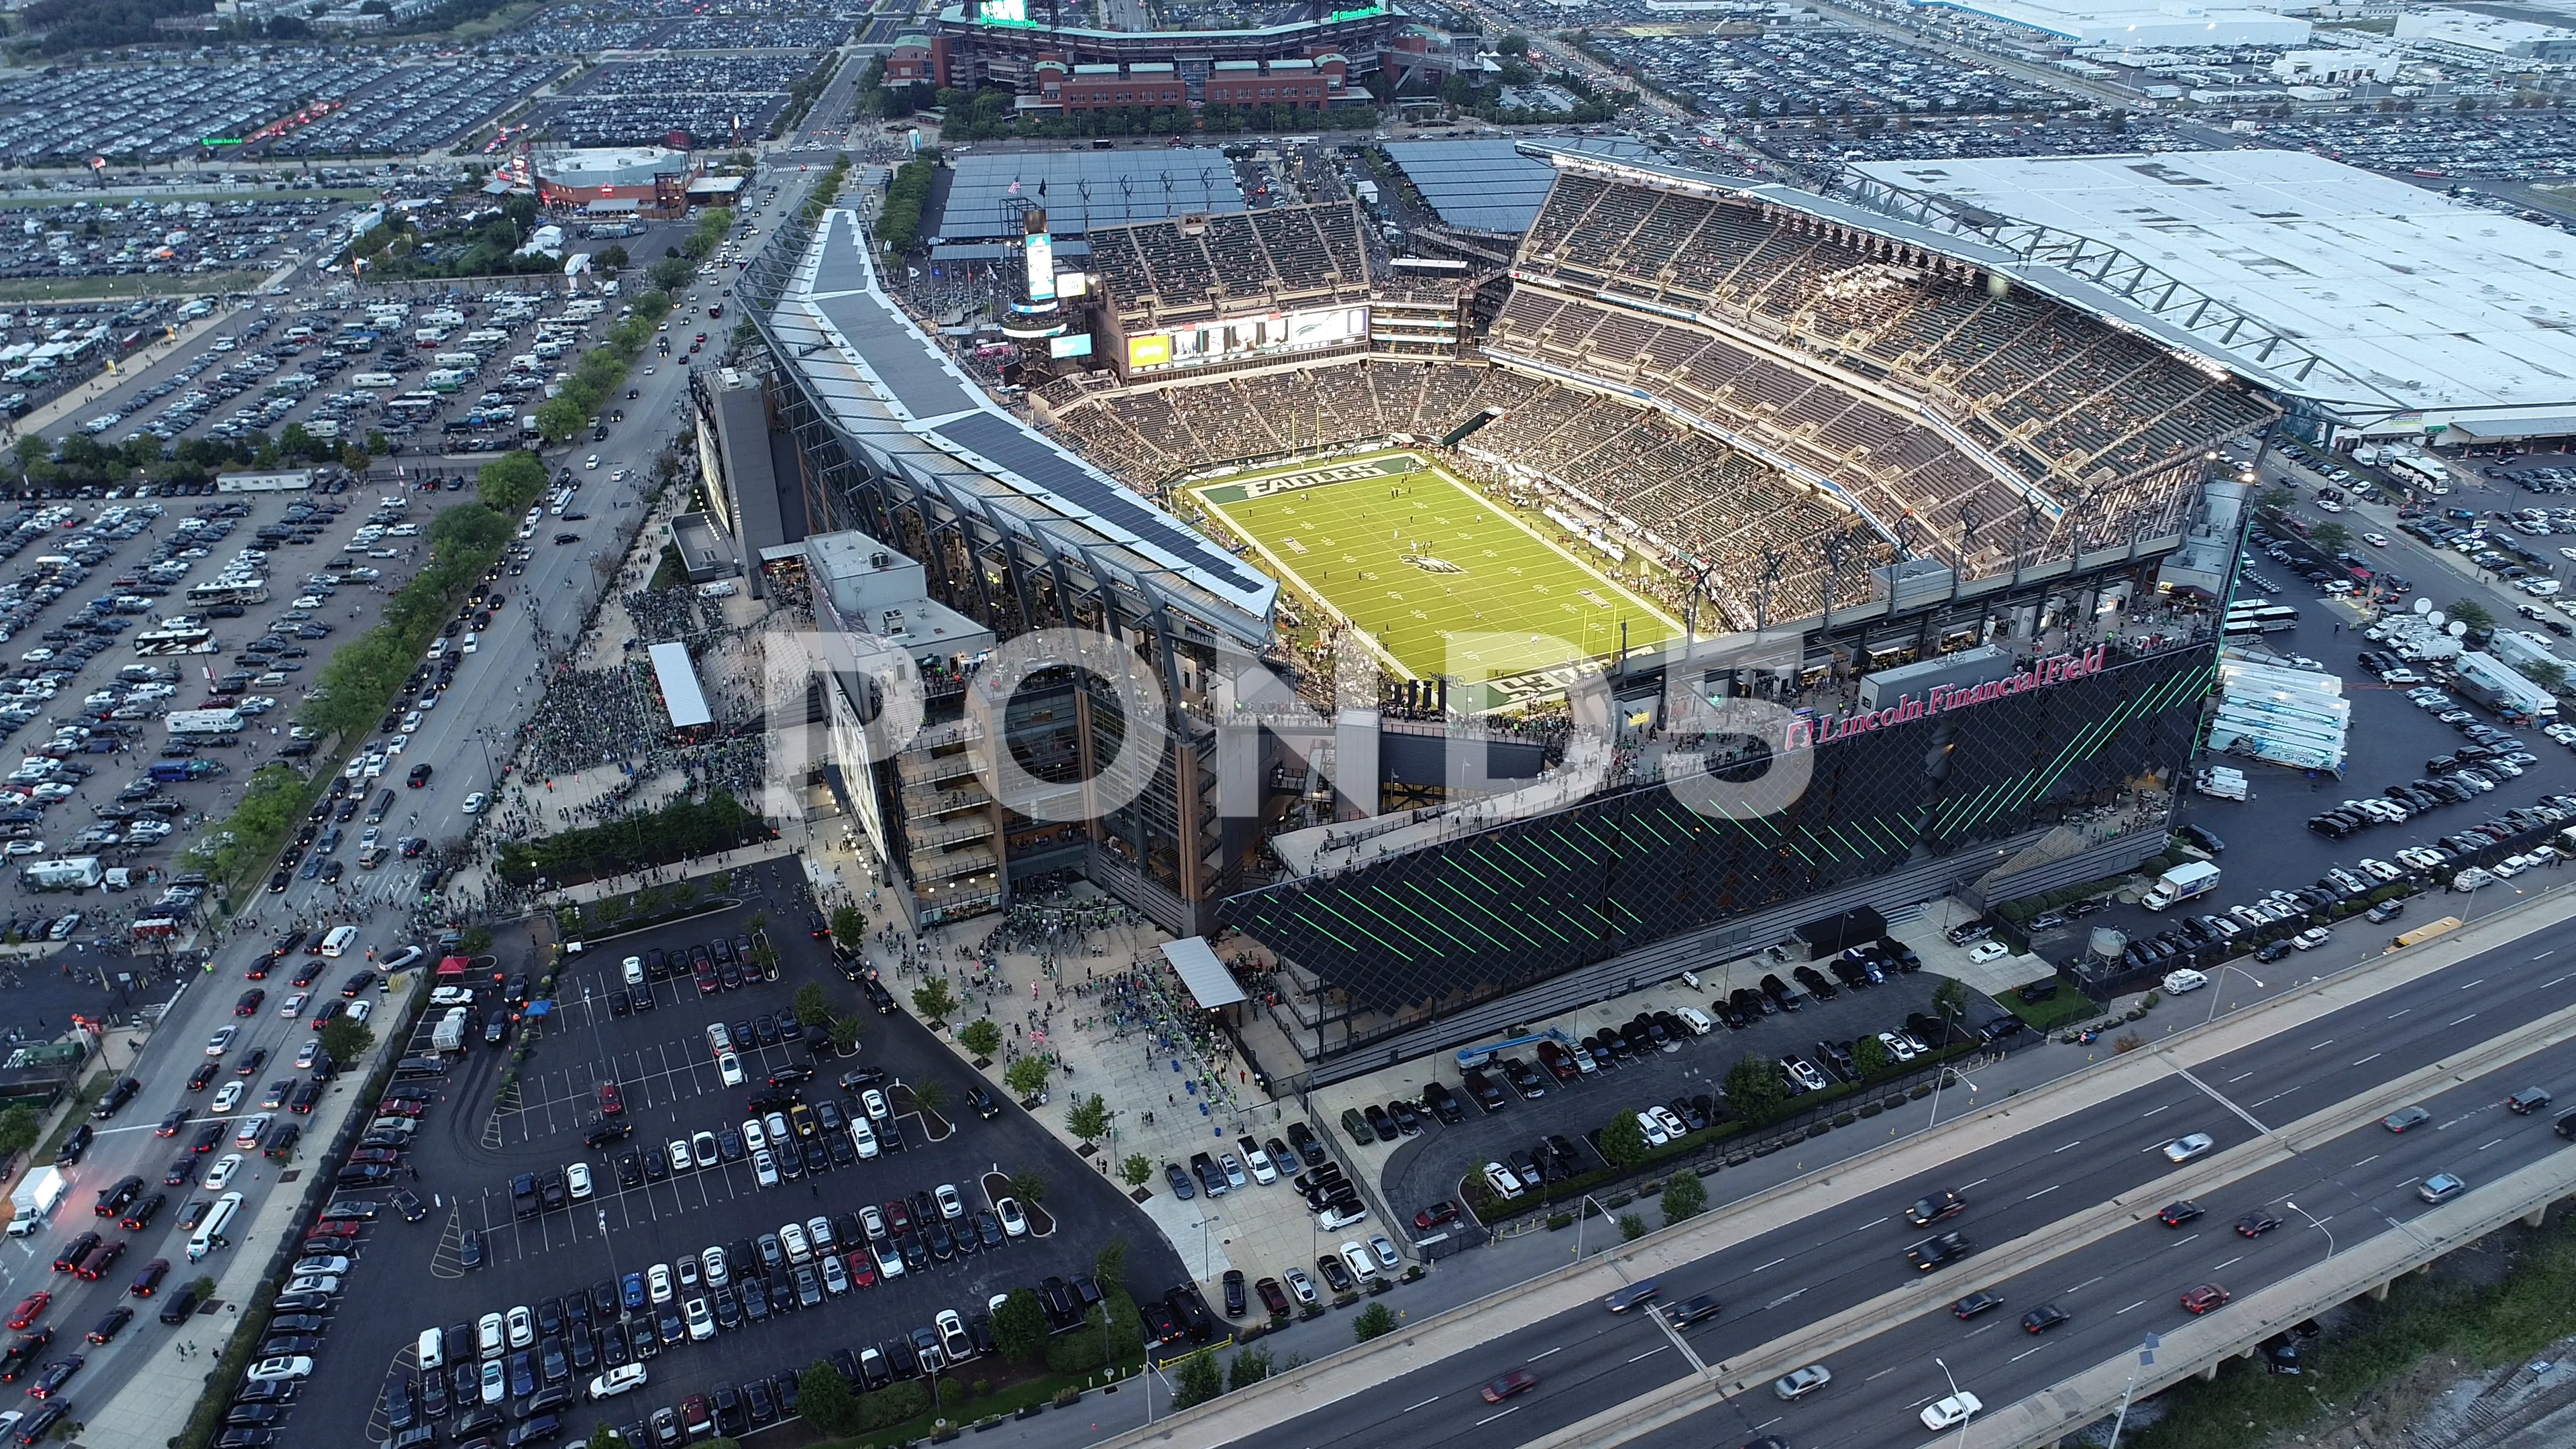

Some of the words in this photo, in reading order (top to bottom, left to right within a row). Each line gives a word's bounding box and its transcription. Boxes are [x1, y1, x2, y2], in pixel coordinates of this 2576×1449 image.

[1236, 464, 1388, 498] EAGLES
[1362, 572, 1378, 581] 50
[1409, 609, 1426, 618] 30
[1434, 629, 1452, 639] 20
[1460, 651, 1479, 660] 10
[1816, 694, 1923, 745] Lincoln
[1927, 659, 2041, 715] Financial
[2039, 643, 2107, 686] Field
[2284, 753, 2315, 765] SHOW
